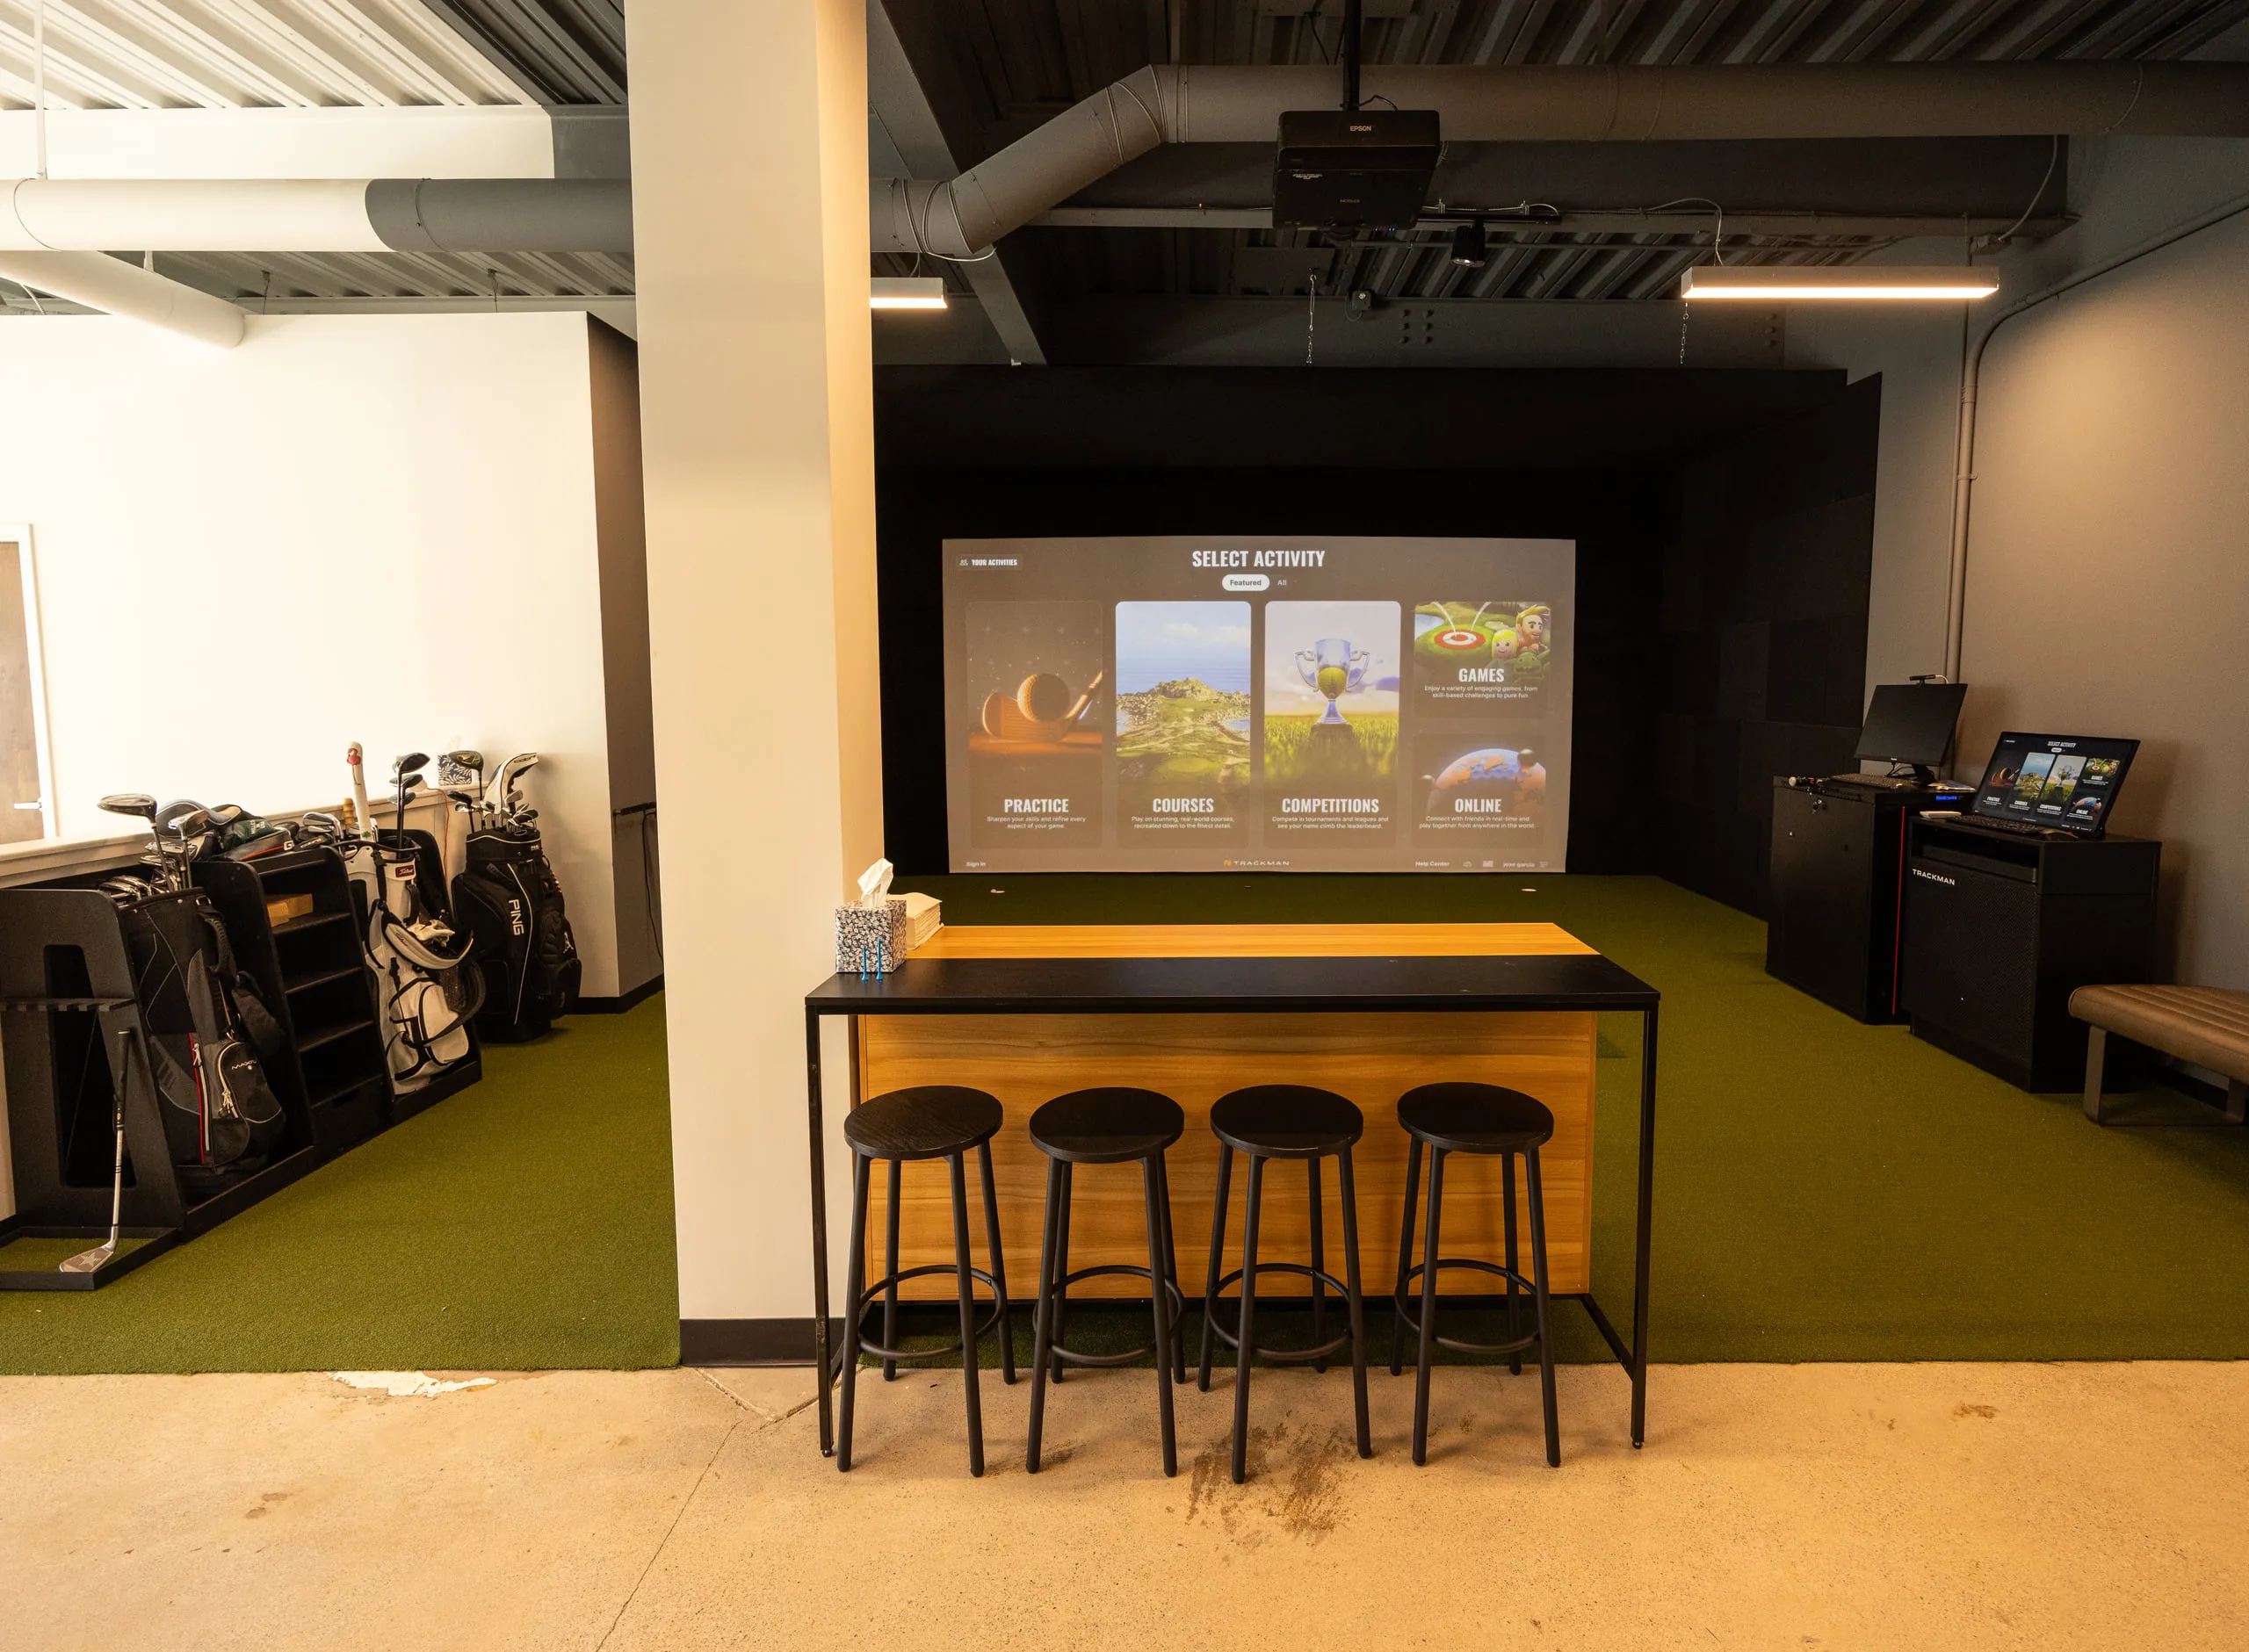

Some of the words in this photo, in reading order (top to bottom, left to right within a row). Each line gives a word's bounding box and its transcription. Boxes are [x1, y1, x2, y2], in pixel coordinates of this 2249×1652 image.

[1192, 550, 1249, 567] SELECT
[1253, 550, 1326, 567] ACTIVITY
[1458, 668, 1505, 682] GAMES
[1004, 798, 1069, 813] PRACTICE
[1153, 797, 1214, 812] COURSES
[1282, 797, 1379, 813] COMPETITIONS
[1455, 798, 1502, 812] ONLINE
[1912, 869, 1956, 885] TRACKMAN
[508, 898, 524, 935] PING
